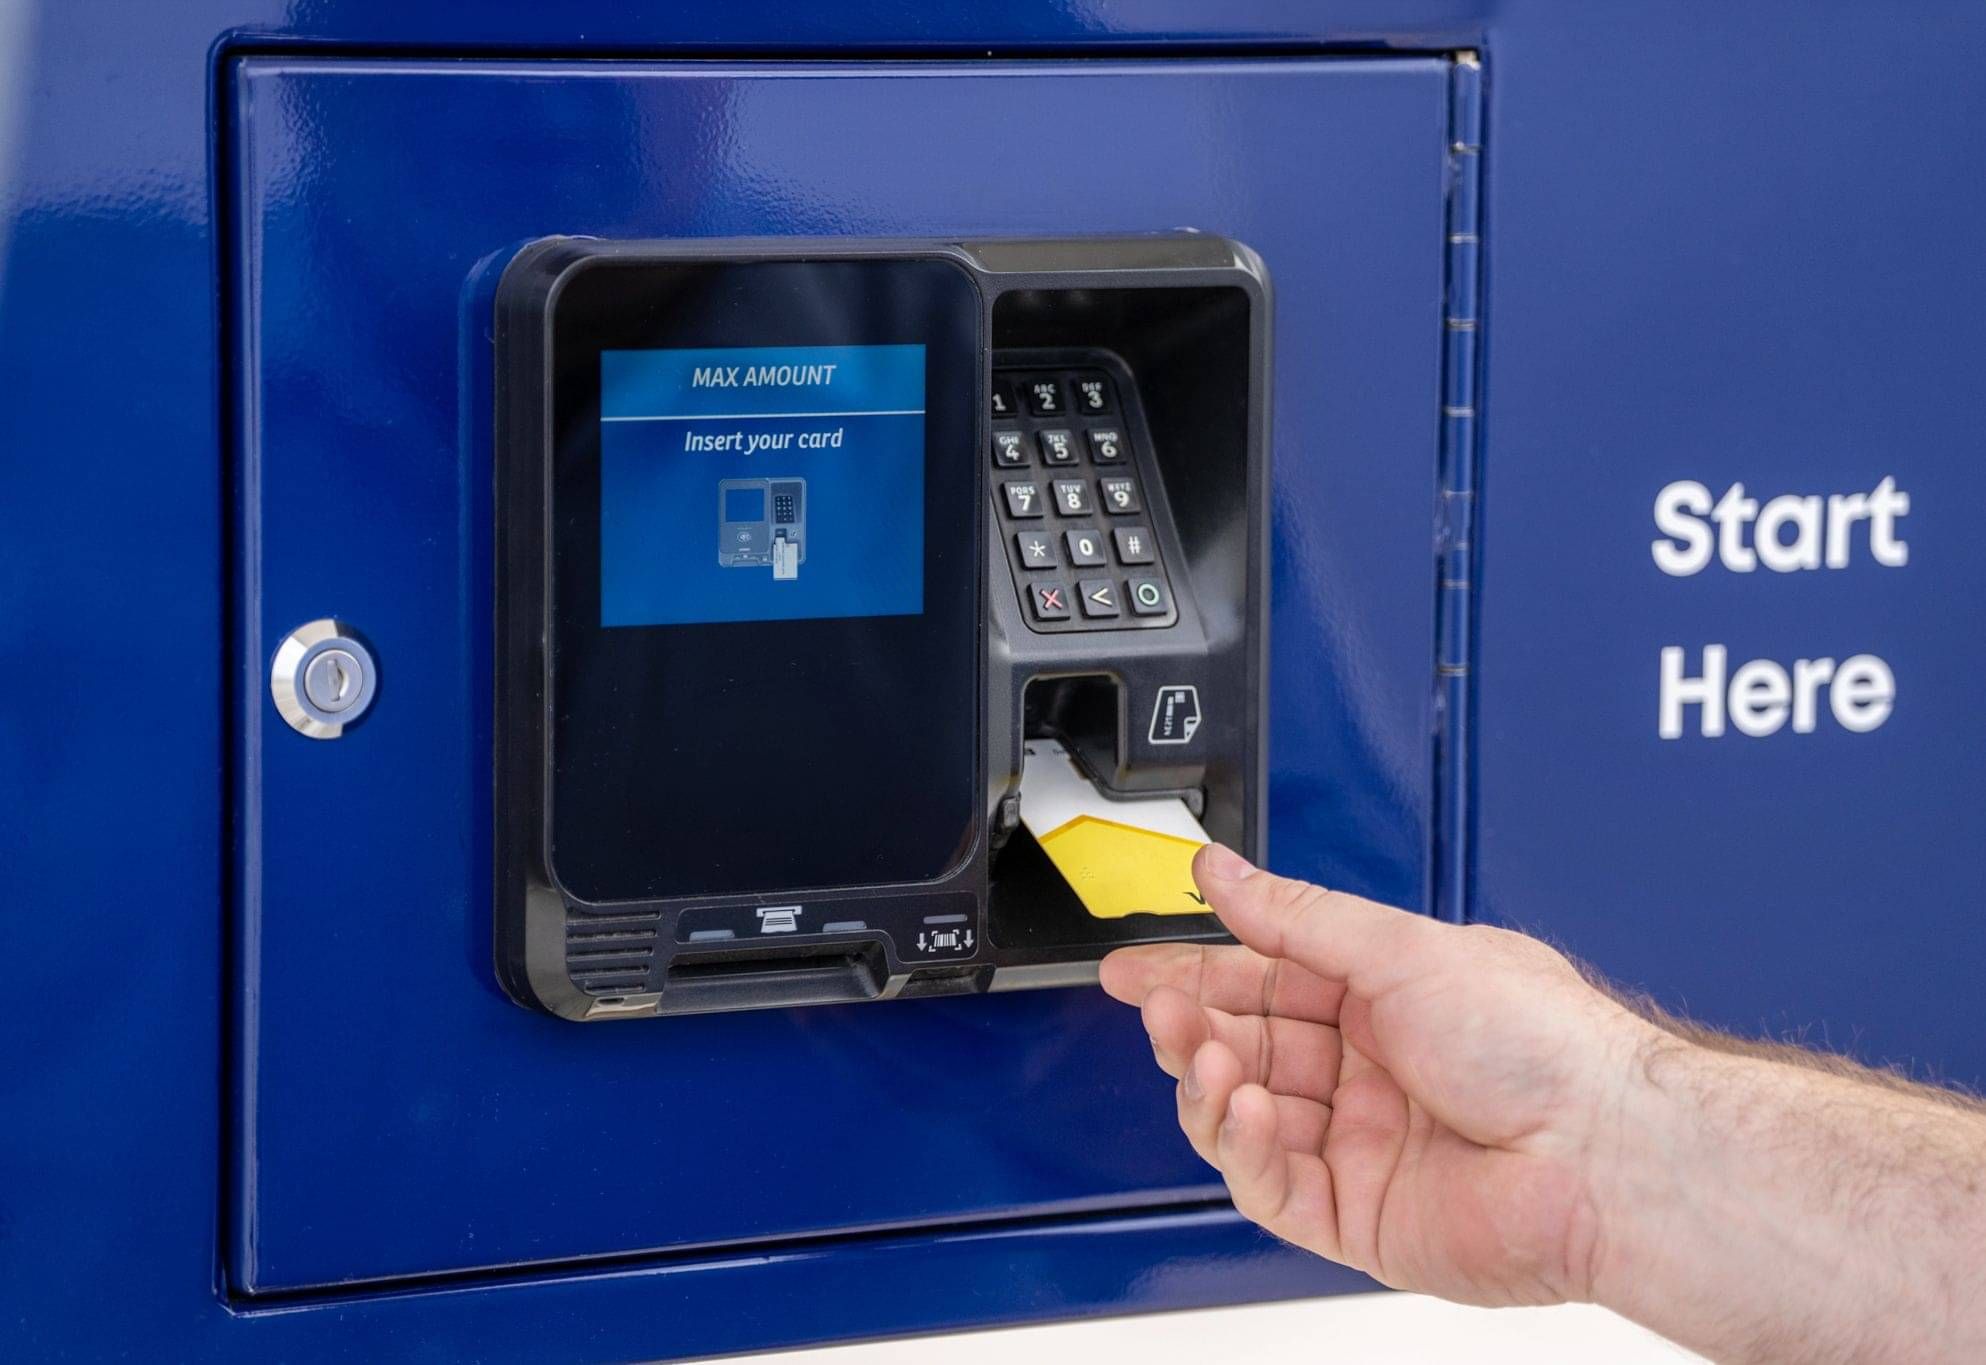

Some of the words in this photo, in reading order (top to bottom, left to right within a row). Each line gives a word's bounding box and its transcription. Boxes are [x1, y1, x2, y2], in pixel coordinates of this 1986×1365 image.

[692, 366, 740, 388] MAX
[743, 364, 837, 387] AMOUNT
[992, 394, 1006, 411] 1
[1040, 392, 1056, 410] 2
[1087, 390, 1104, 409] 3
[684, 431, 743, 452] Insert
[744, 433, 795, 455] your
[798, 427, 844, 448] card
[1053, 441, 1069, 459] 5
[1101, 441, 1118, 458] 6
[1005, 444, 1020, 461] 4
[1018, 495, 1032, 511] 7
[1067, 492, 1081, 509] 8
[1114, 491, 1130, 508] 9
[1651, 475, 1910, 577] Start
[1079, 538, 1093, 556] 0
[1658, 643, 1896, 740] Here
